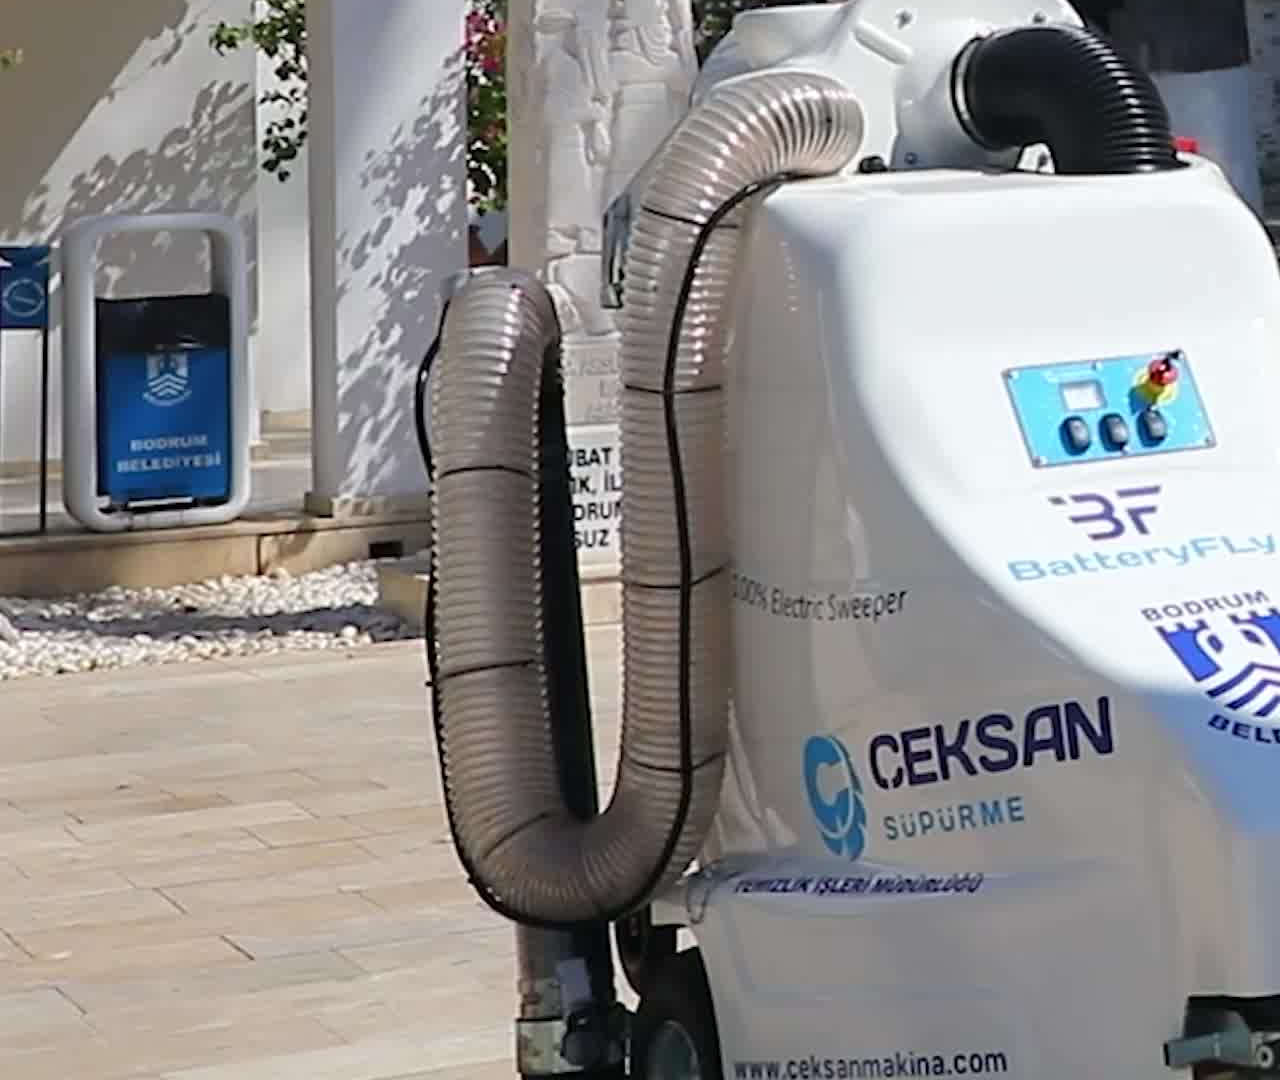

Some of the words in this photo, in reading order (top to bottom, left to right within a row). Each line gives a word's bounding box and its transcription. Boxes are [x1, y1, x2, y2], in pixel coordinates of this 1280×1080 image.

[130, 435, 207, 451] BODRUM
[570, 448, 612, 468] BAT
[1007, 533, 1277, 581] BatteryFLy
[826, 589, 908, 623] Sweeper
[1140, 589, 1270, 622] BODRUM
[734, 1051, 1008, 1080] www.ceksanmakina.com
